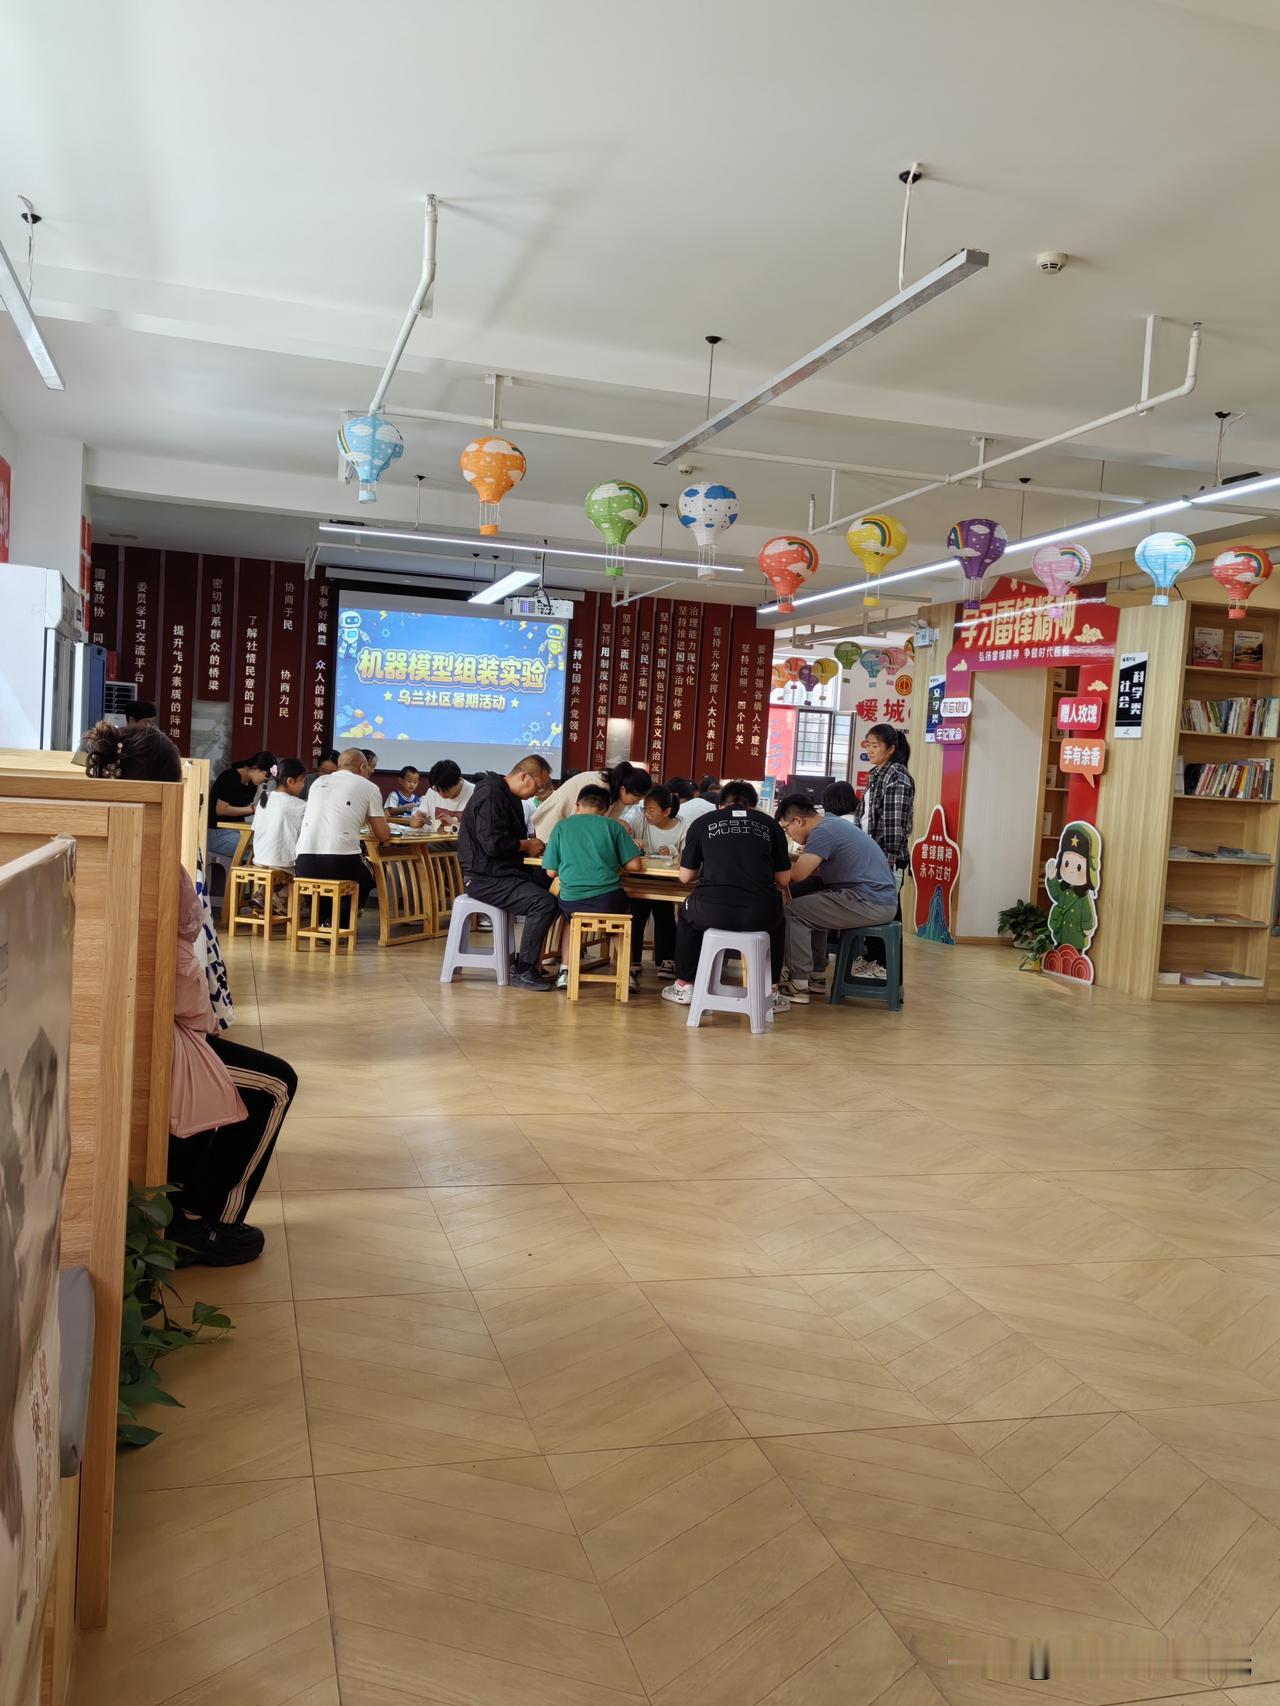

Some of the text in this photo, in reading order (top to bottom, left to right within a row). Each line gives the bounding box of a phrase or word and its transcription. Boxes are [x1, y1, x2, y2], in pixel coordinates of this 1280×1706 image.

[134, 581, 148, 683] 委员学习交流平台
[208, 578, 223, 691] 密切联系群众的桥梁
[279, 581, 295, 718] 协商于民 协商为民
[316, 585, 329, 647] 有事好商量
[685, 606, 699, 686] 治理能力现代化
[961, 592, 1077, 649] 学习雷锋精神
[169, 624, 184, 738] 提升能力素质的阵地
[243, 615, 258, 726] 了解社情民意的窗口
[358, 649, 547, 690] 机器模型组装实验
[569, 638, 583, 743] 坚持中国共产党领导
[594, 623, 611, 769] 坚持用制度体系保障人民当
[617, 613, 631, 706] 坚持全面依法治国
[637, 631, 650, 711] 坚持民主集中制
[672, 605, 688, 732] 坚持推进国家治理体系和
[705, 626, 722, 763] 坚持充分发挥人大代表作用
[1119, 680, 1131, 709] 社会
[1130, 670, 1145, 715] 科学类
[397, 689, 507, 711] 乌兰社区暑期活动
[750, 644, 767, 757] 要求加强各级人大建设
[1060, 703, 1098, 724] 赠人玫瑰
[1063, 745, 1100, 767] 手有余香
[920, 862, 952, 882] 永不过时
[921, 843, 953, 863] 雷锋精神
